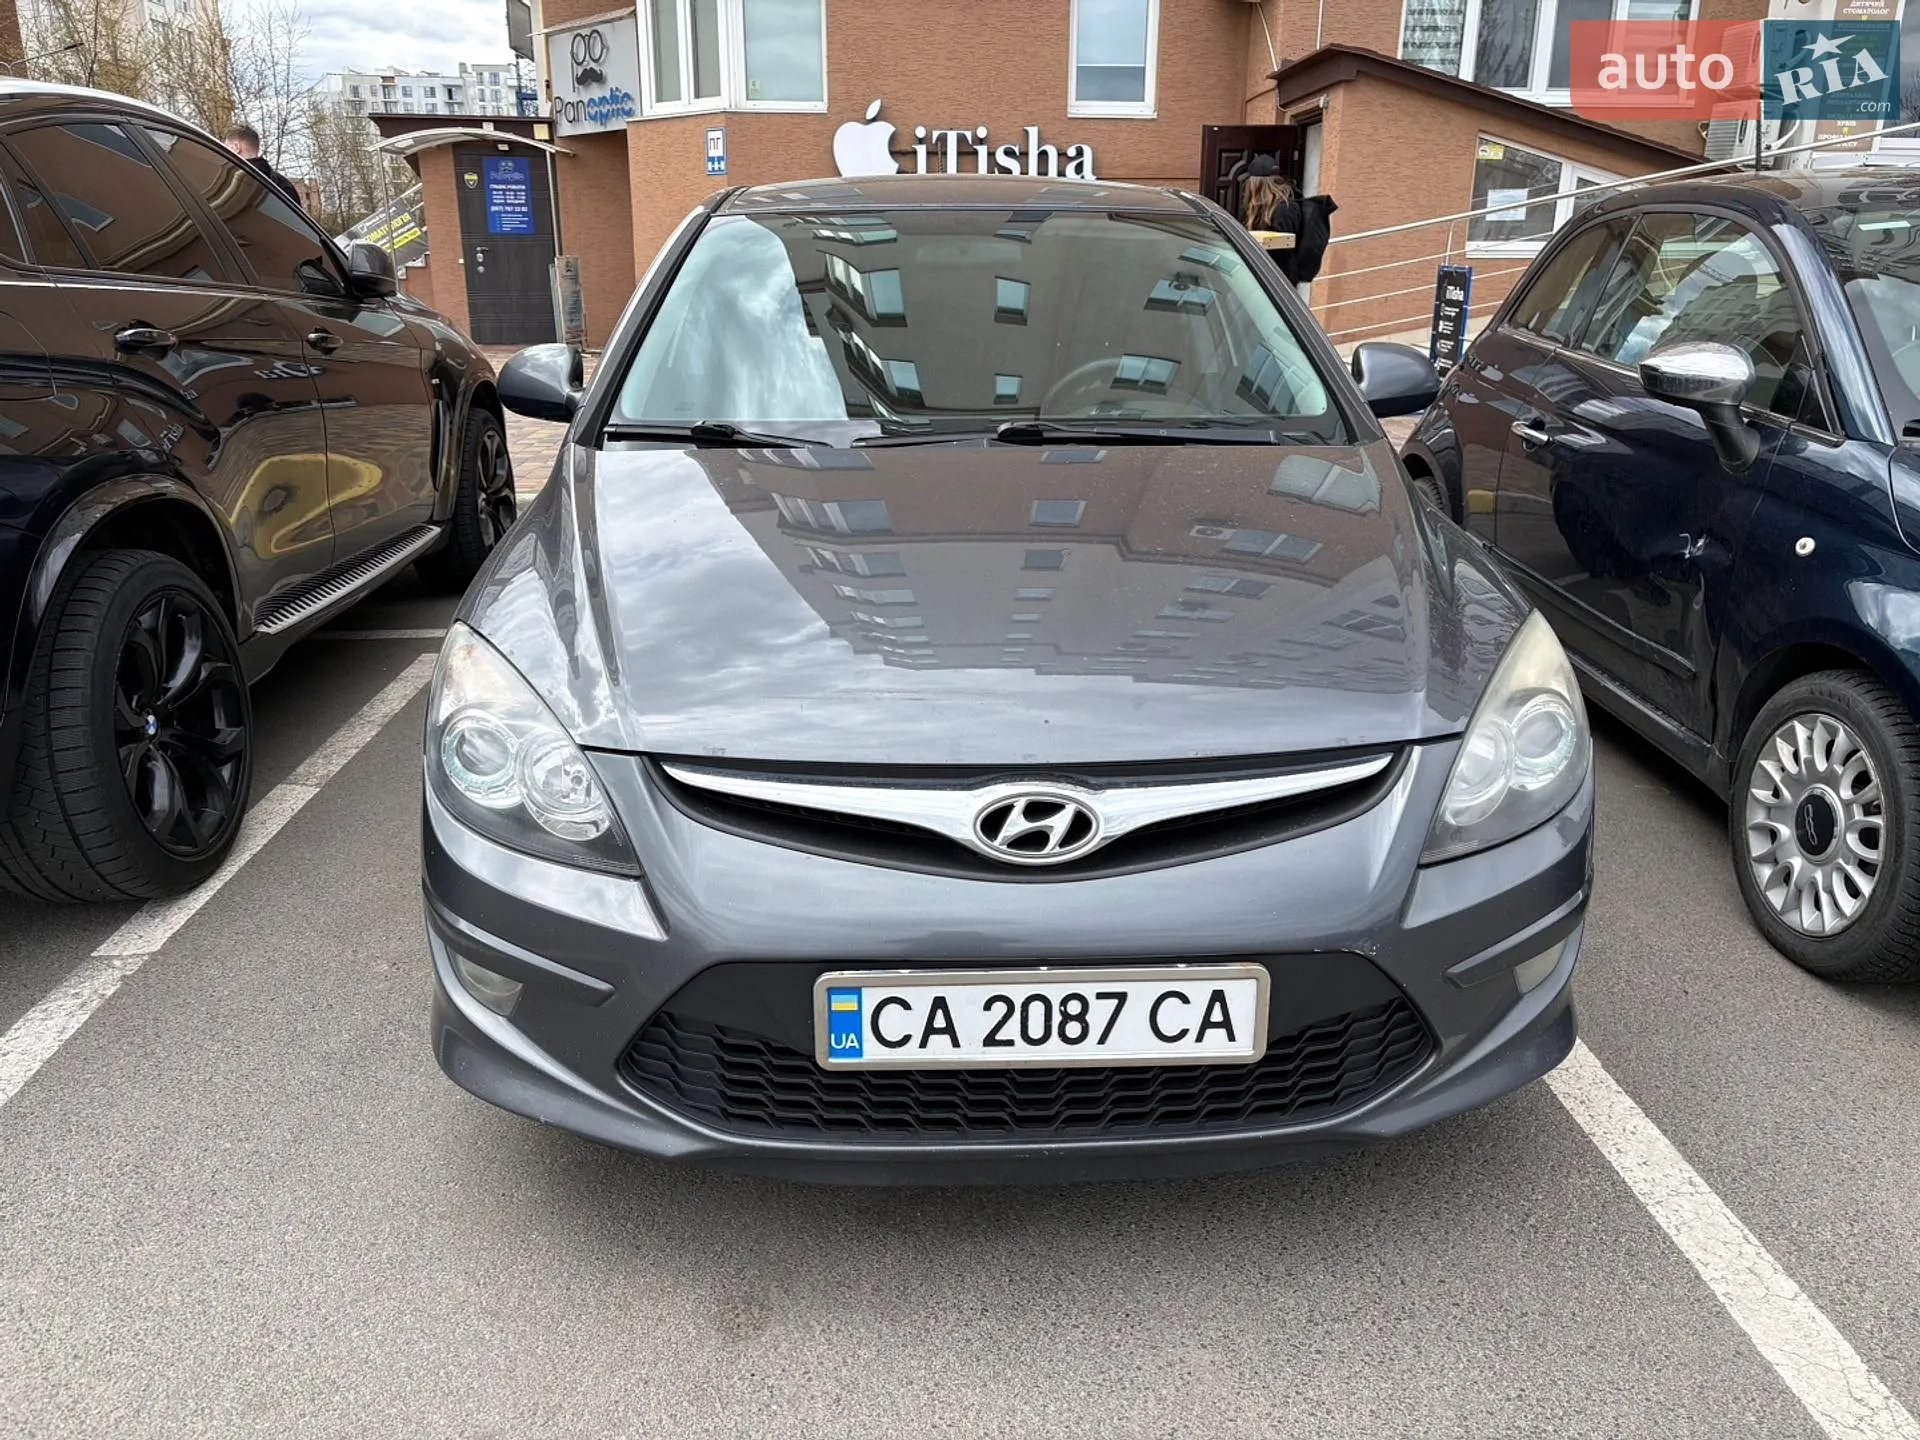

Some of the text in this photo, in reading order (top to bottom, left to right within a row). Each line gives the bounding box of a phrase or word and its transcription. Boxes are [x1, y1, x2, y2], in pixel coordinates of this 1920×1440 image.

[912, 125, 1097, 180] iTisha
[831, 1034, 860, 1050] UA
[870, 989, 1236, 1049] CA 2087 CA
